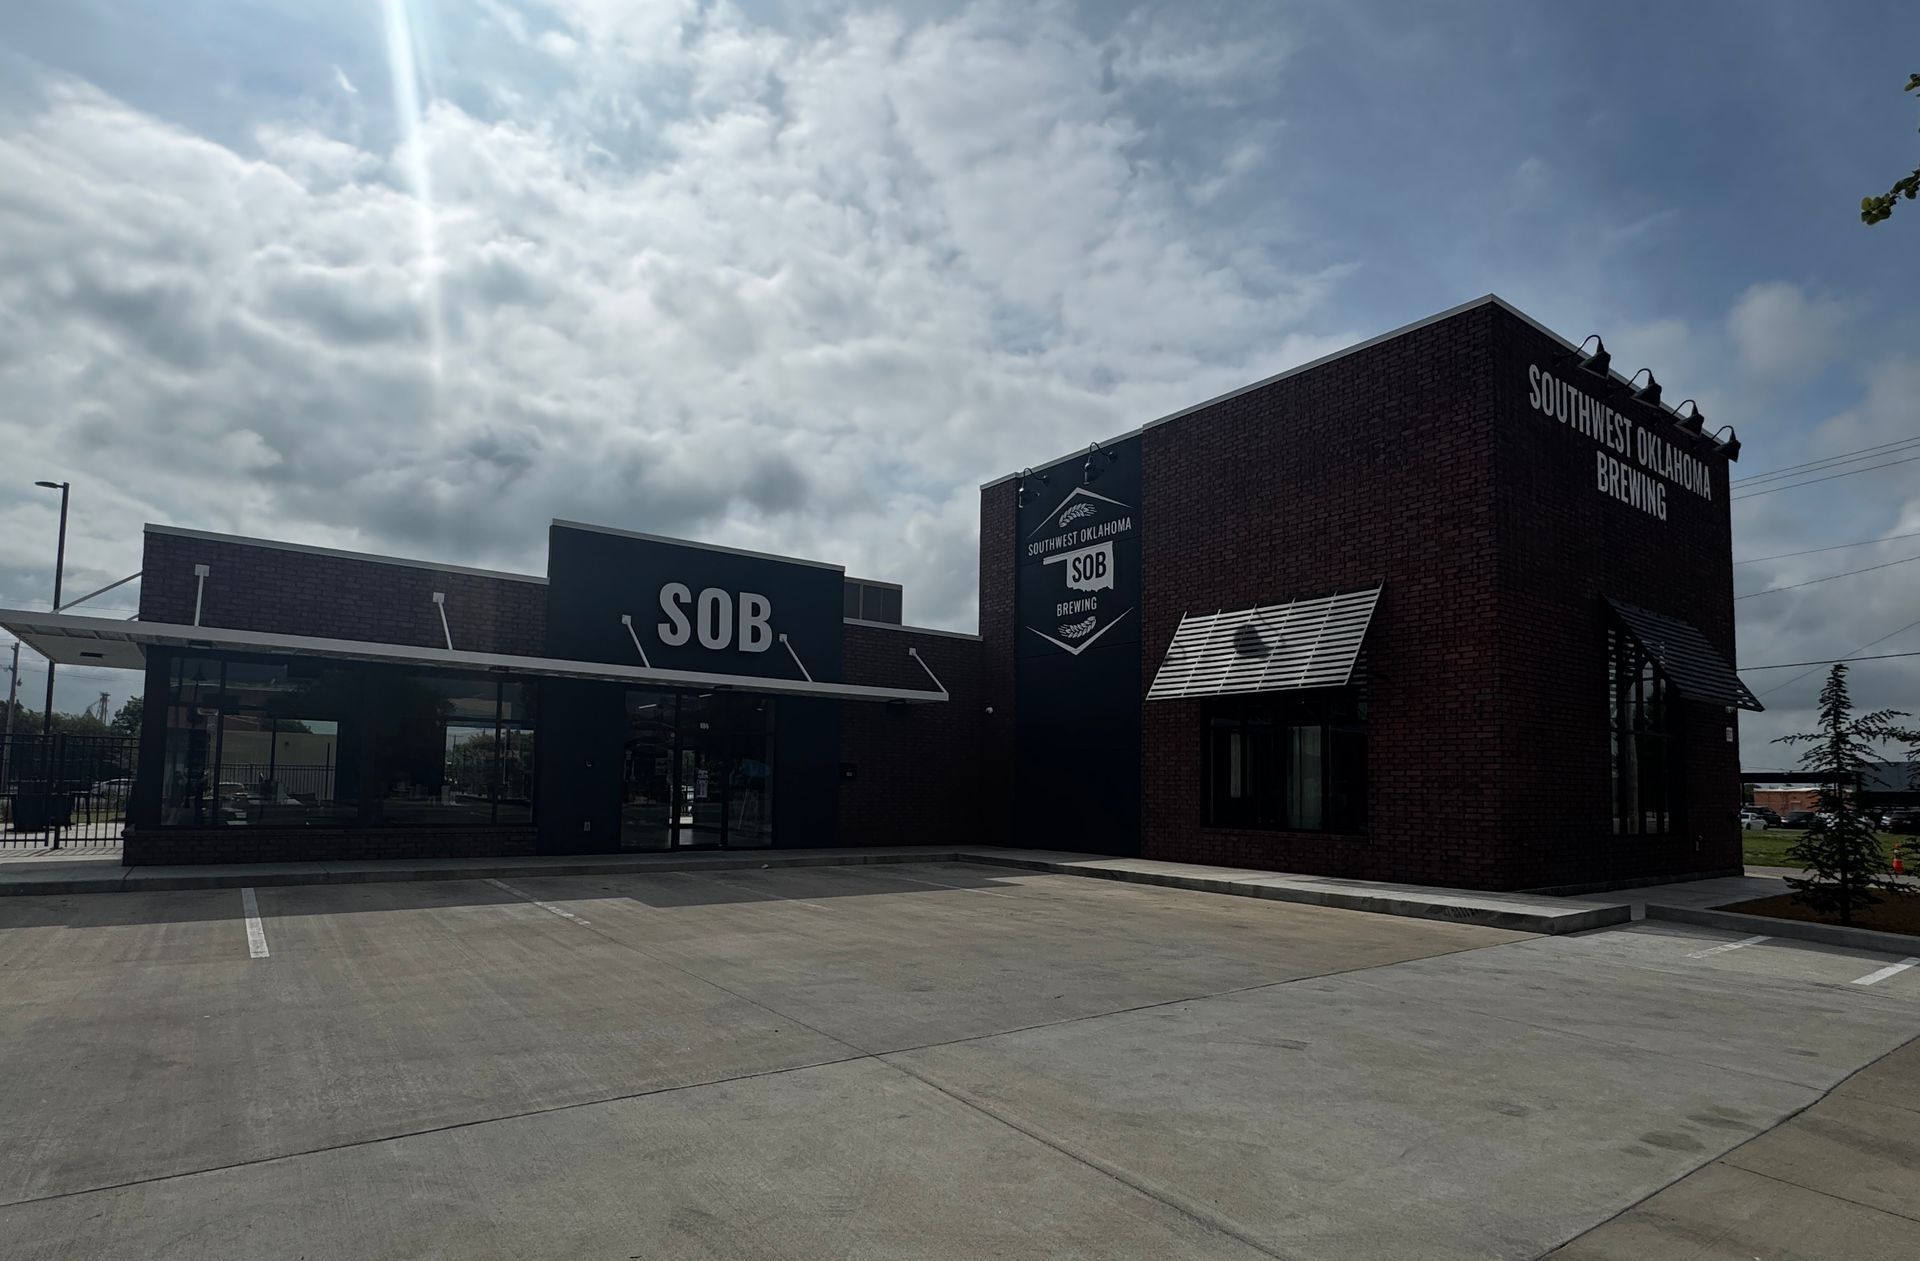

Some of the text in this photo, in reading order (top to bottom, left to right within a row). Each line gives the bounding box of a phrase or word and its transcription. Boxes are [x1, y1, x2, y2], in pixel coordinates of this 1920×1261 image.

[1529, 364, 1712, 501] SOUTHWEST OKLAHOMA
[1597, 450, 1667, 521] BREWING
[1028, 516, 1132, 557] SOUTHWEST OKLAHOMA
[1072, 551, 1107, 583] SOB
[657, 582, 773, 653] SOB
[1056, 596, 1097, 617] BREWING
